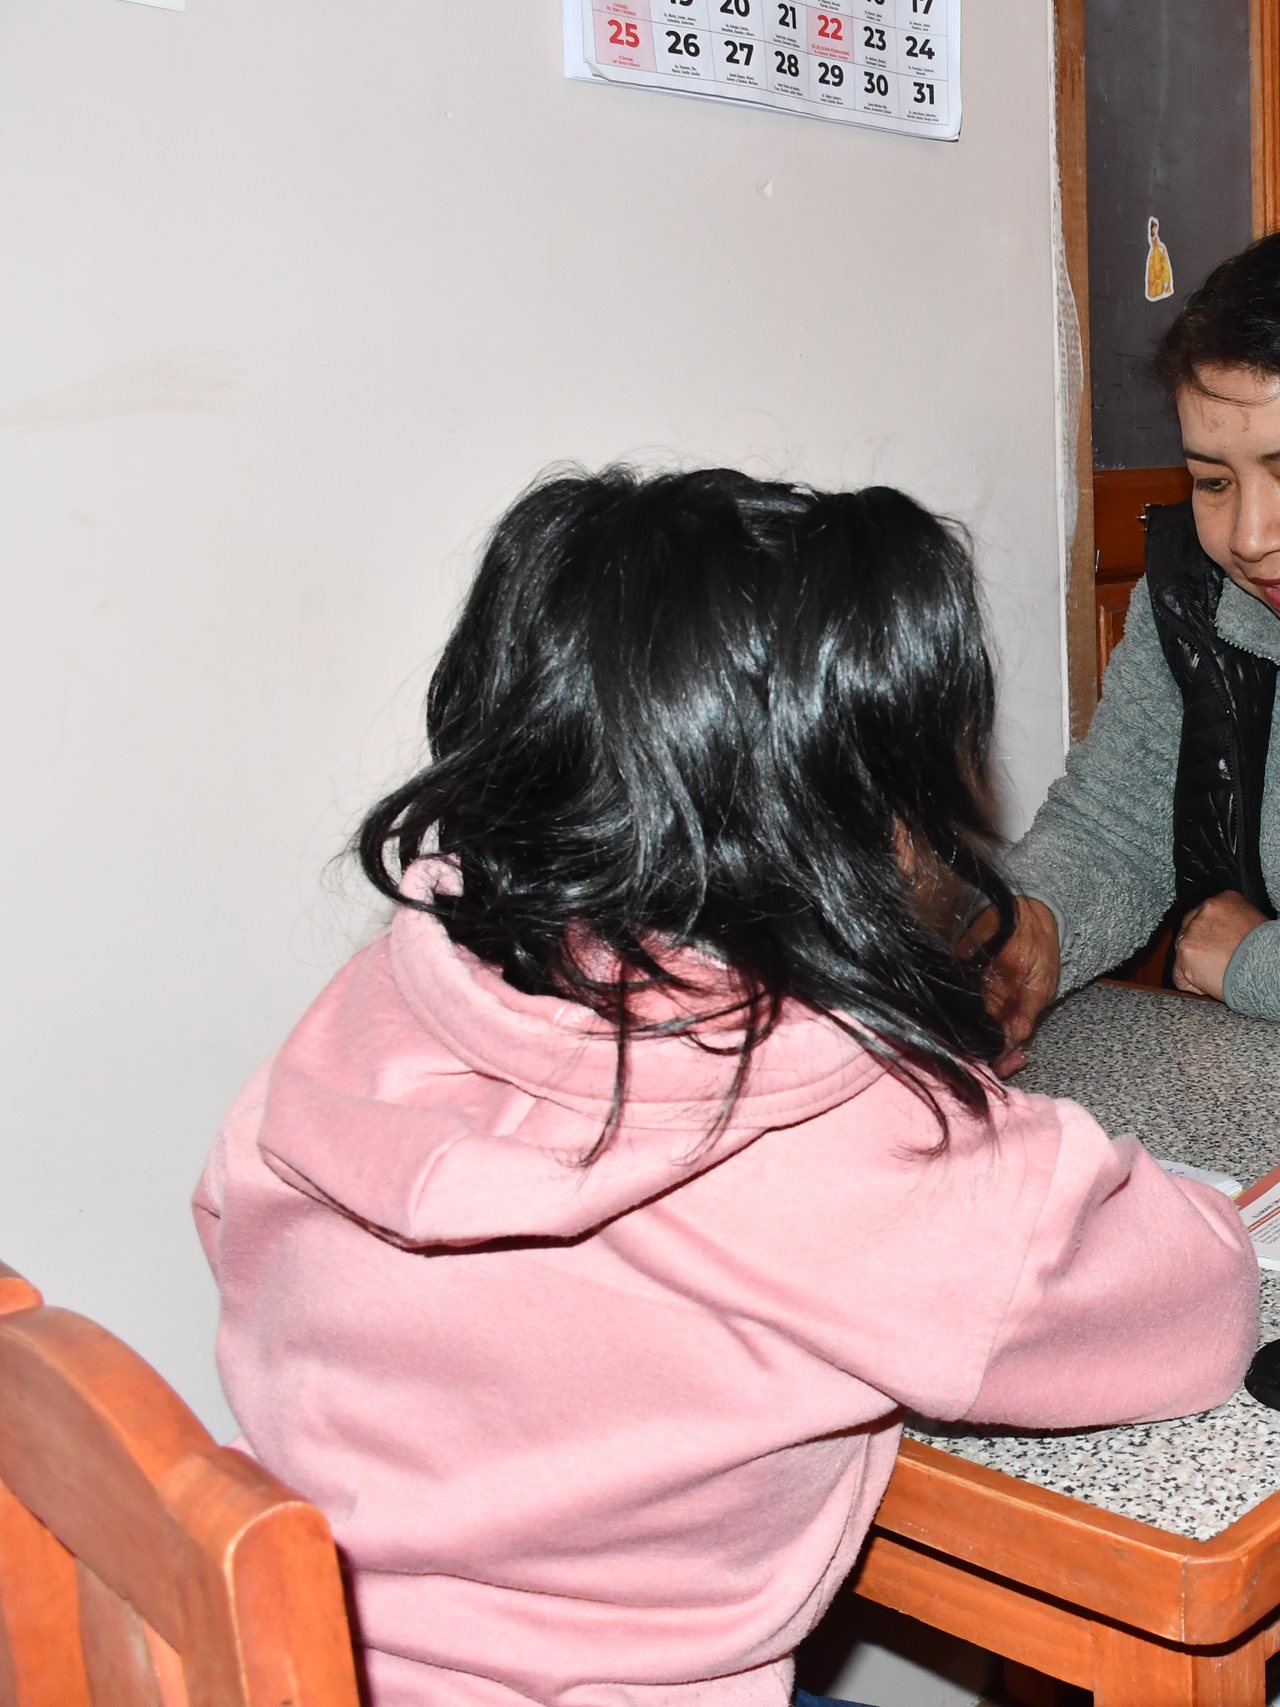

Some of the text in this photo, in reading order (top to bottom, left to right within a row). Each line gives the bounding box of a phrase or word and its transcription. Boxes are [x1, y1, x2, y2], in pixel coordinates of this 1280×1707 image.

[720, 0, 749, 17] 20
[778, 4, 796, 29] 21
[818, 16, 843, 40] 22
[864, 26, 886, 50] 23
[906, 36, 935, 59] 24
[913, 0, 932, 14] 17
[609, 19, 640, 48] 25
[666, 31, 700, 57] 26
[724, 41, 753, 65] 27
[775, 51, 799, 77] 28
[818, 62, 843, 87] 29
[864, 72, 888, 96] 30
[914, 82, 934, 104] 31
